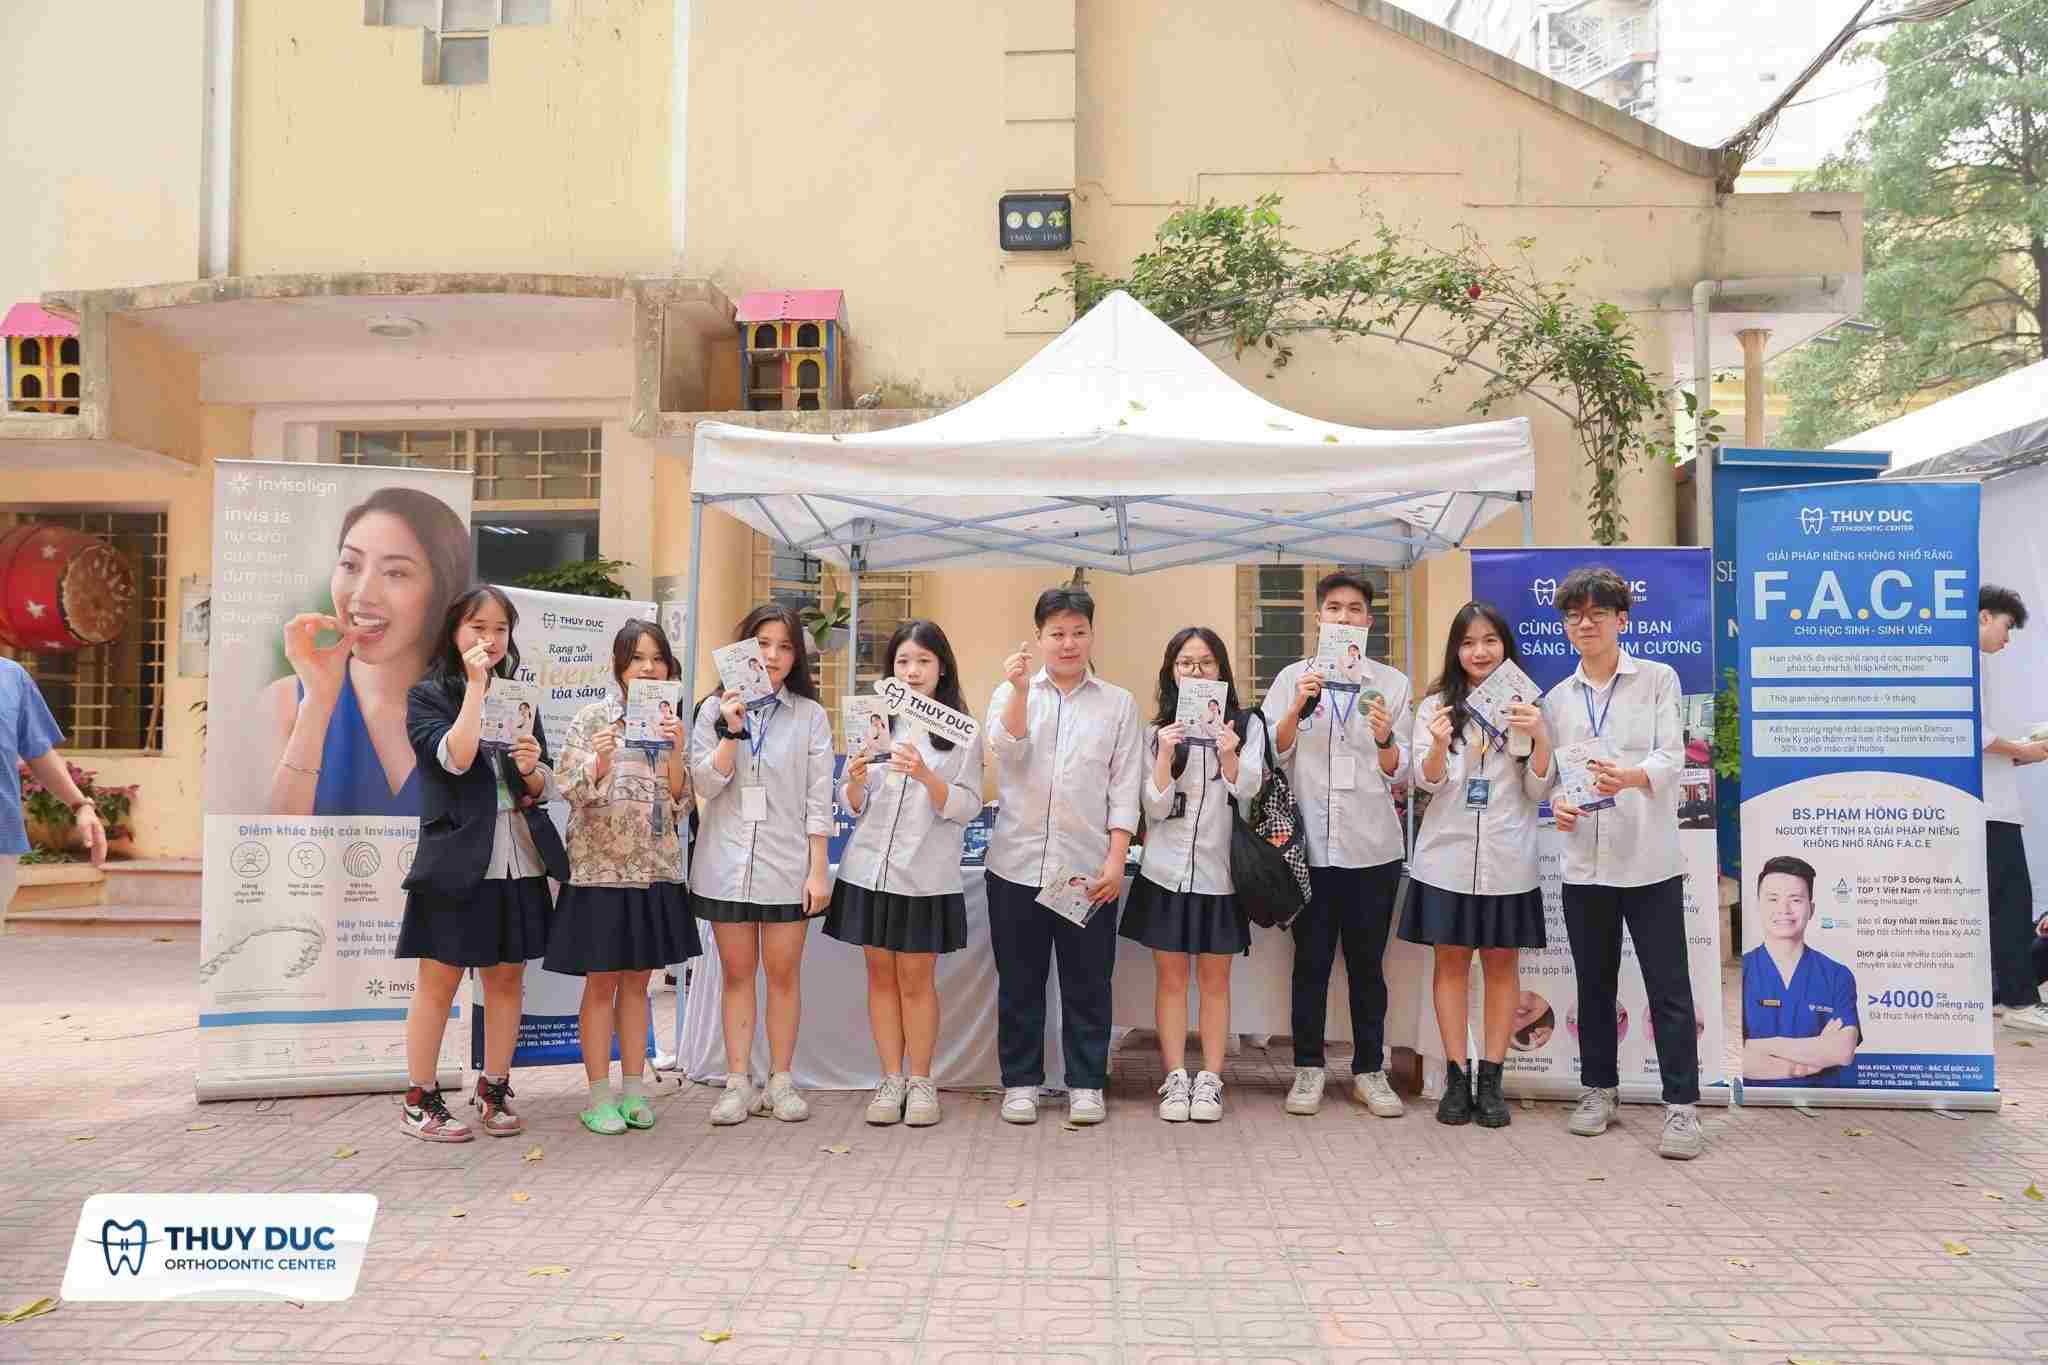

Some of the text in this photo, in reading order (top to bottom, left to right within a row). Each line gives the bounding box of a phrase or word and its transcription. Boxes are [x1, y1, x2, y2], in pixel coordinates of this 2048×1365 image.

[256, 477, 337, 496] invisalign
[1830, 510, 1913, 522] THUY DUC
[560, 616, 604, 628] THUY DUC
[1518, 619, 1562, 636] CÙNG
[1638, 621, 1672, 637] BẠN
[1522, 640, 1565, 655] SÁNG
[1644, 640, 1702, 655] CƯƠNG
[910, 696, 975, 734] THUY DUC
[1792, 804, 1945, 822] BS.PHẠM HỒNG ĐỨC
[364, 825, 418, 842] Invisalig
[389, 981, 416, 992] invis
[1867, 990, 1934, 1008] >4000
